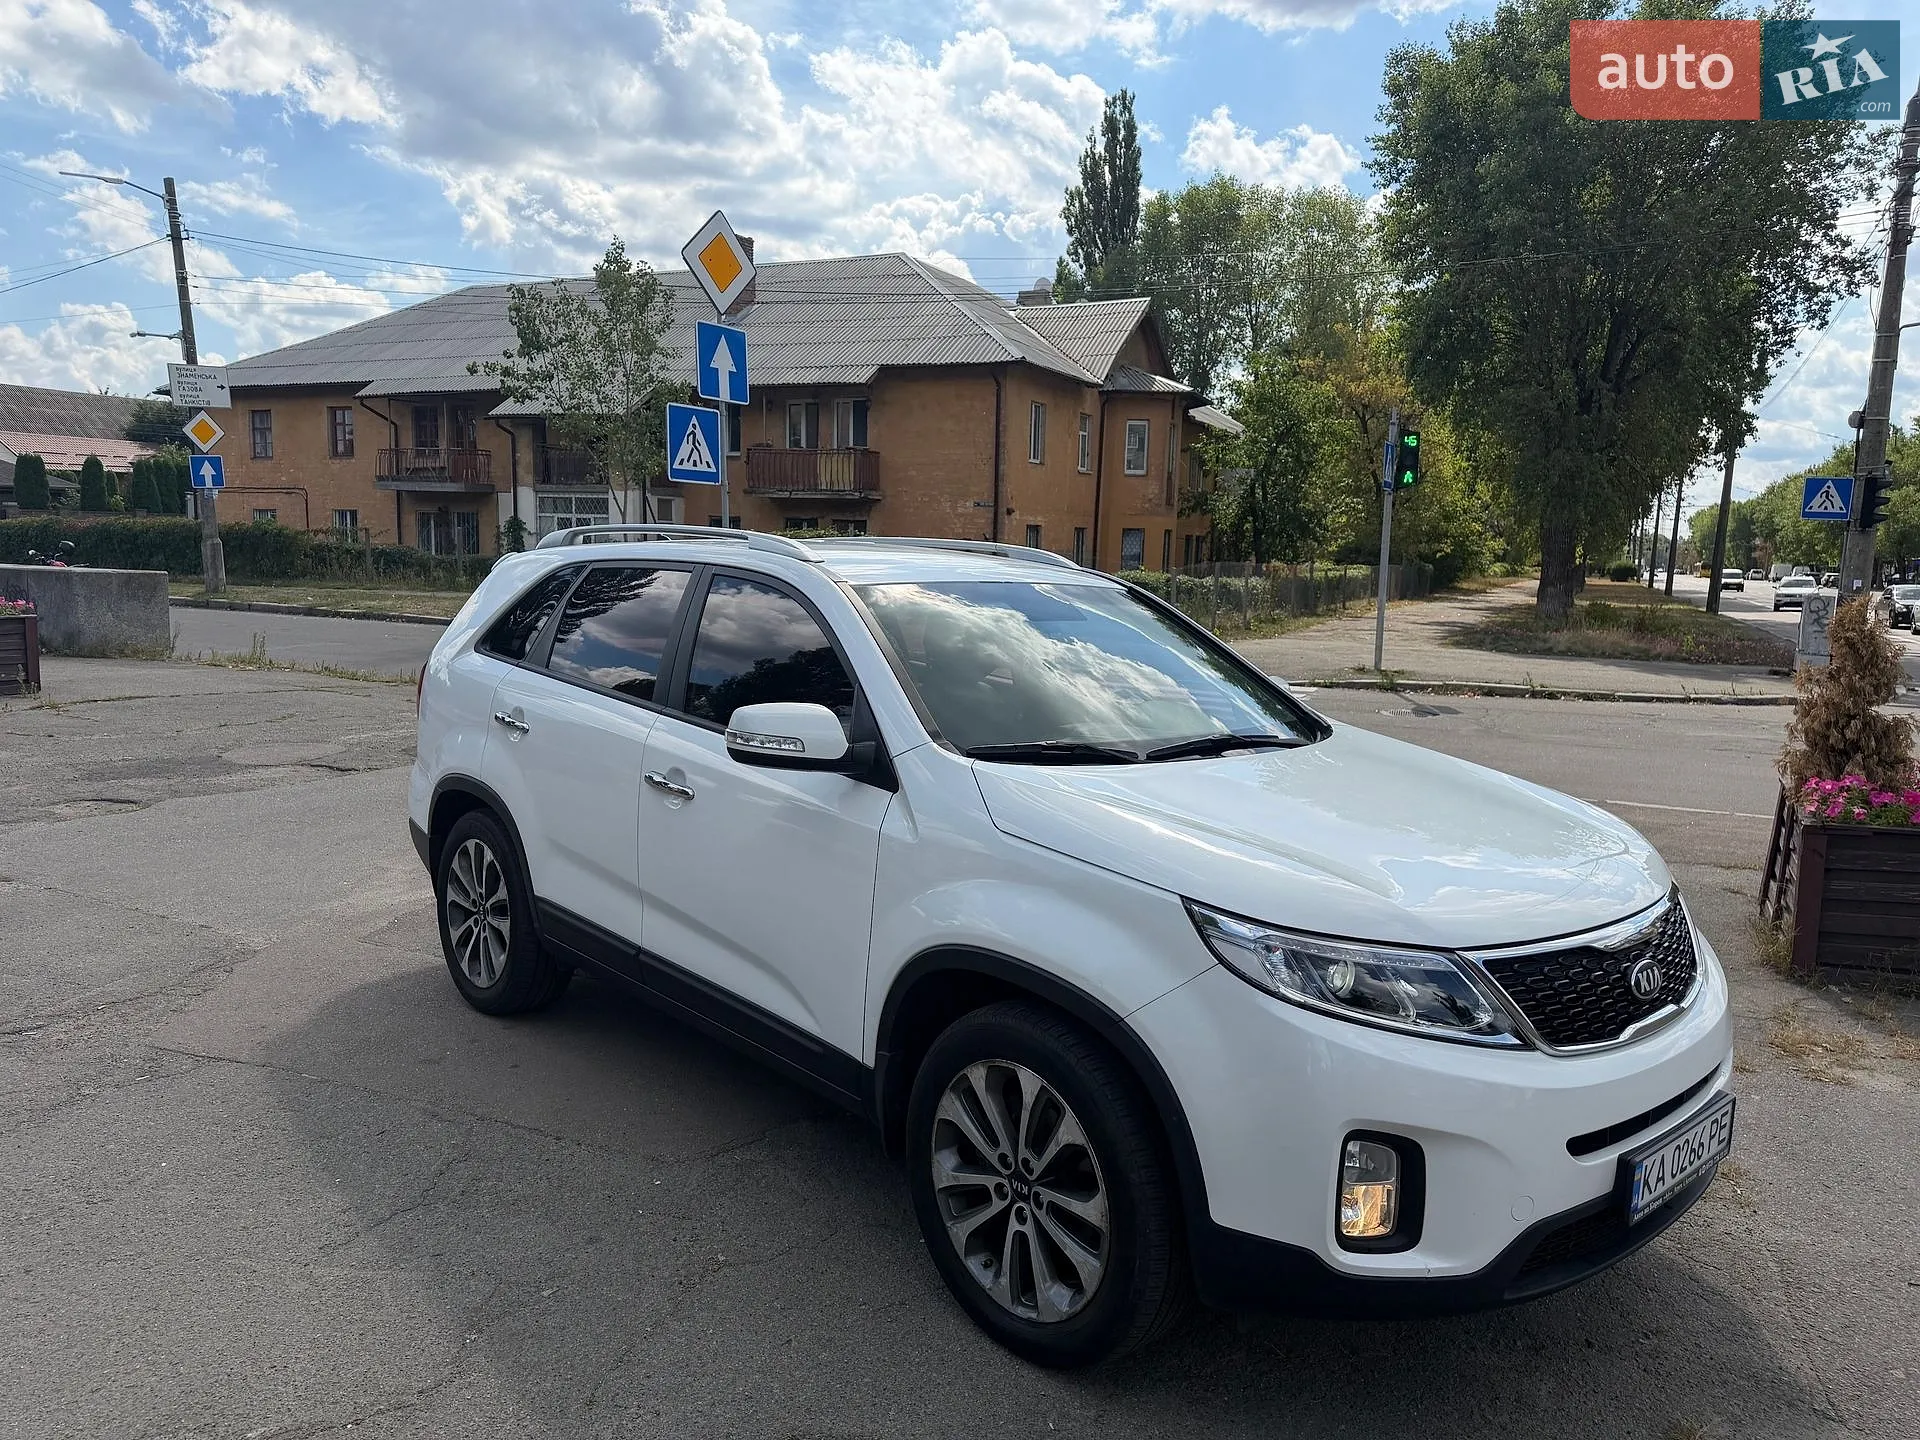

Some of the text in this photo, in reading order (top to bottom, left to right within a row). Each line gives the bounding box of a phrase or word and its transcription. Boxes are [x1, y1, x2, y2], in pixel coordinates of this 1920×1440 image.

[176, 372, 217, 380] ЗНАМЕНСЬКА
[1405, 435, 1417, 446] 45
[1637, 966, 1661, 993] KIA
[1641, 1153, 1666, 1201] KA
[1671, 1124, 1707, 1179] 0266
[1707, 1108, 1729, 1154] PE
